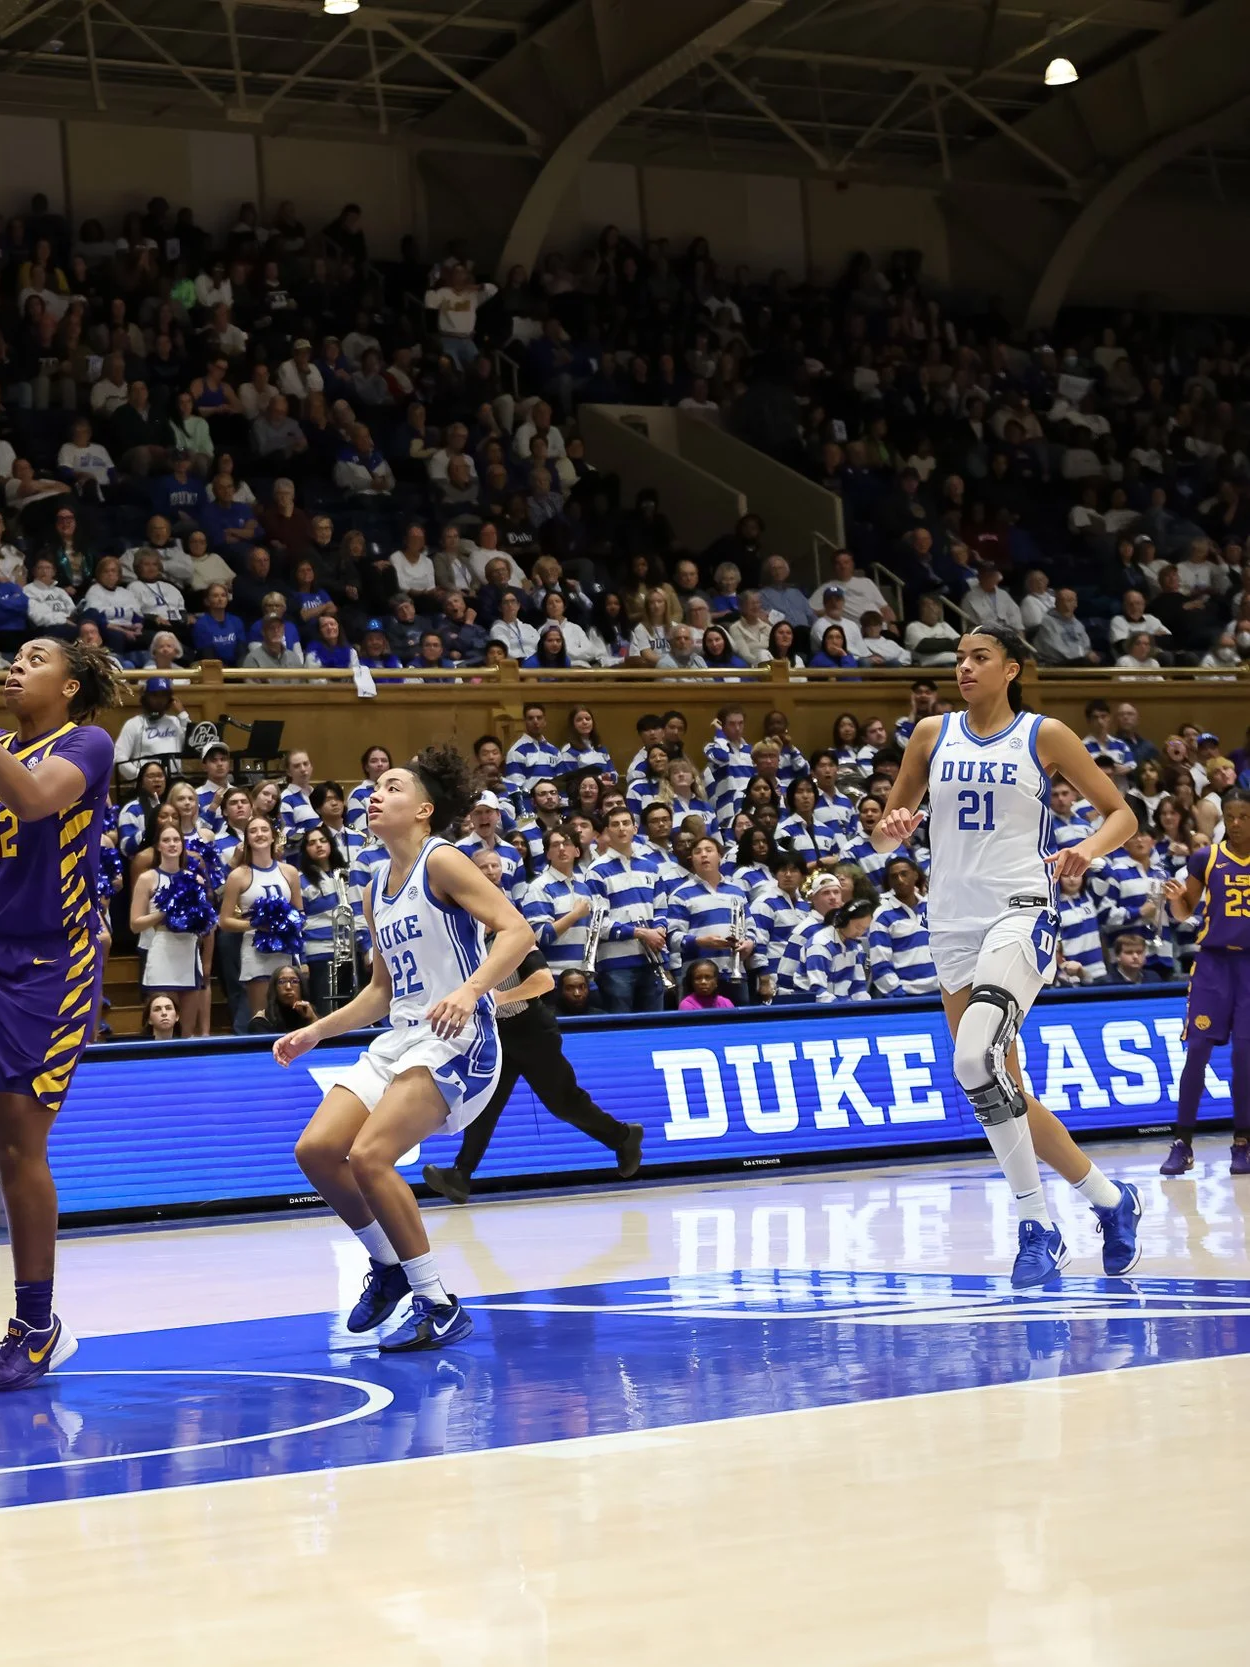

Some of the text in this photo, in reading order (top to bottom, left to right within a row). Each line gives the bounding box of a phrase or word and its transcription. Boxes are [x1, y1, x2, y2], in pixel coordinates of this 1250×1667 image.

[145, 728, 177, 739] Duke
[940, 761, 1018, 785] DUKE
[958, 790, 995, 831] 21
[391, 949, 424, 998] 22
[652, 1033, 946, 1141] DUKE
